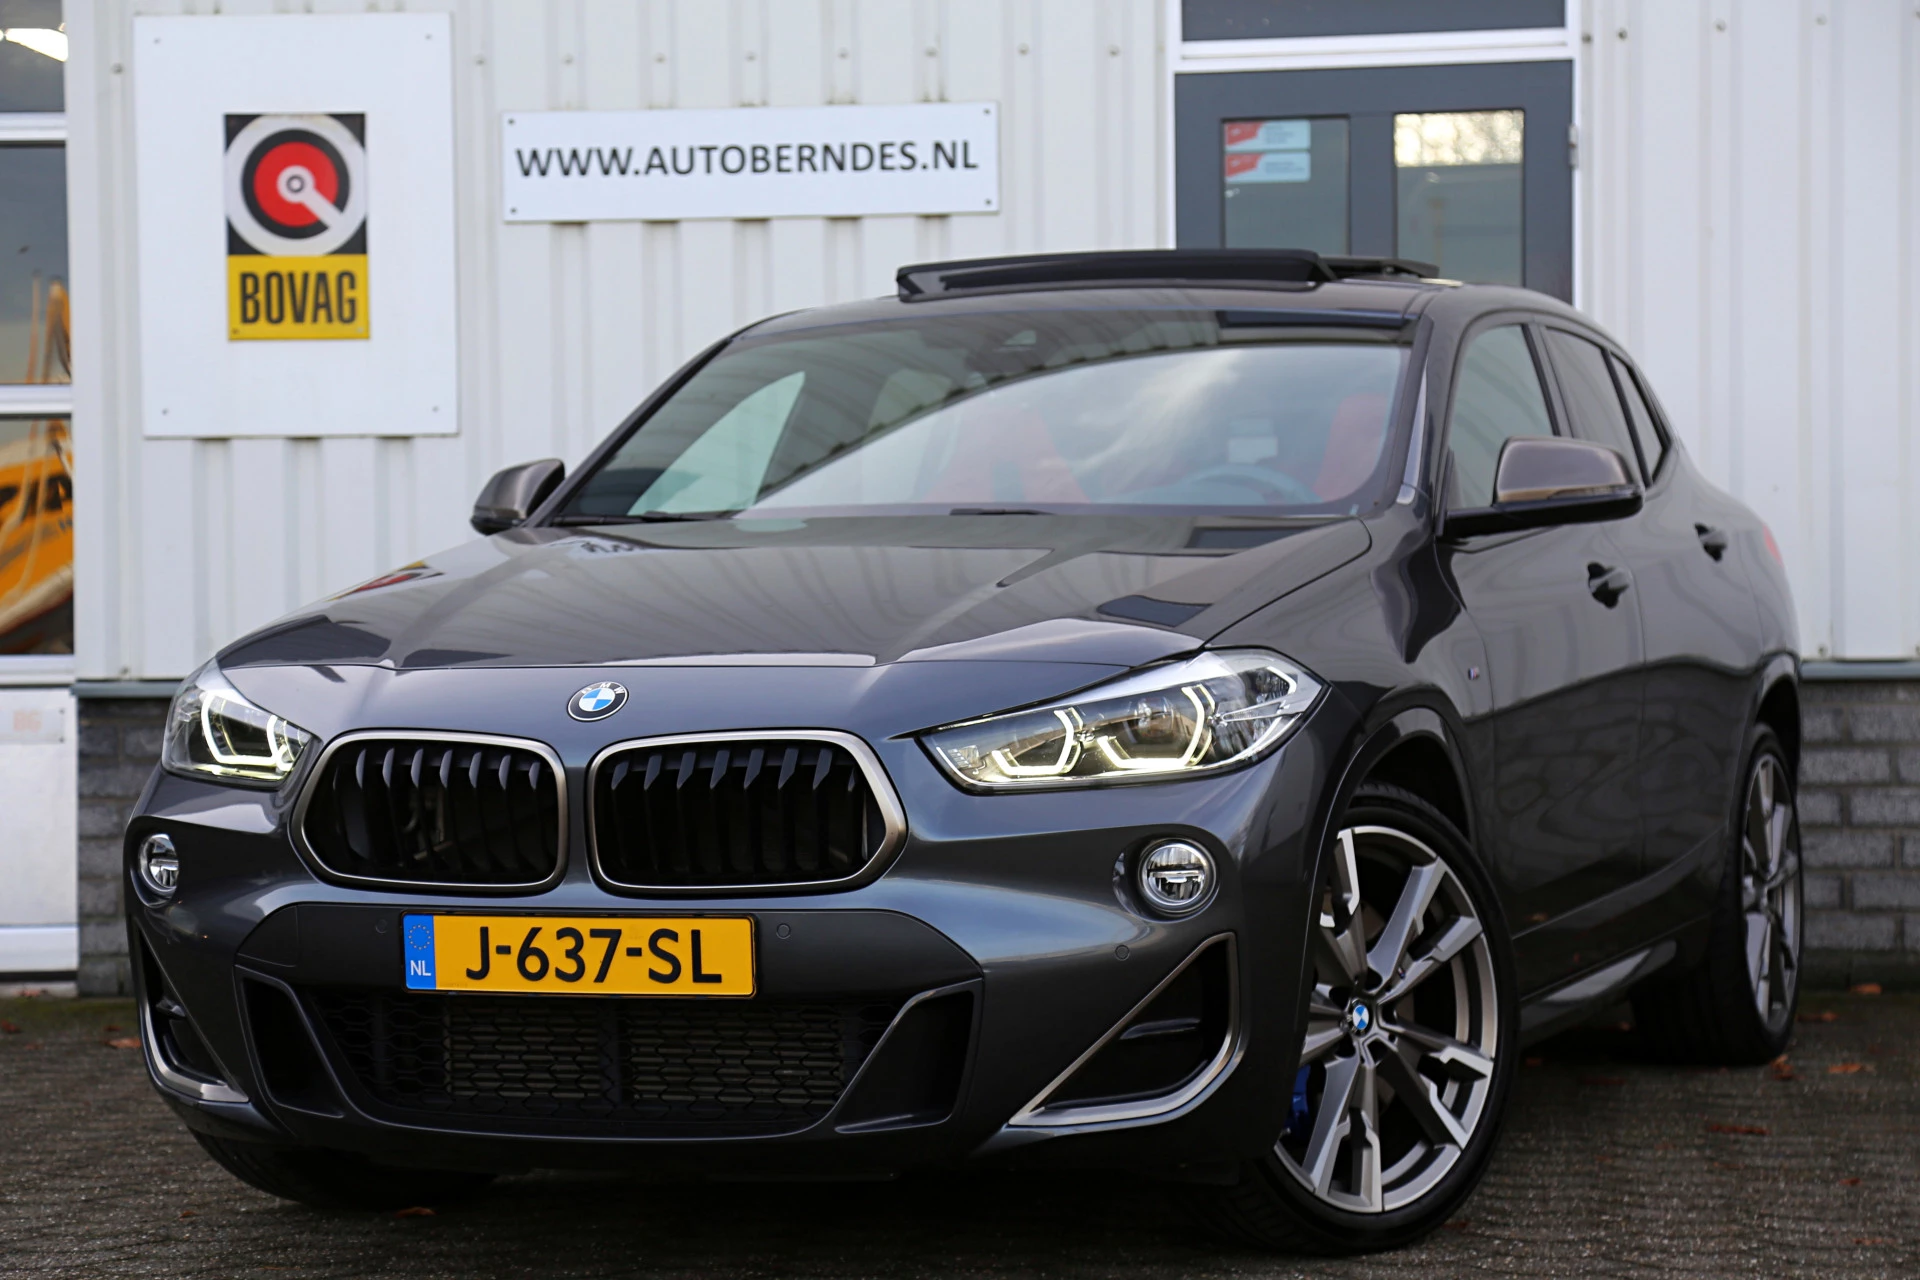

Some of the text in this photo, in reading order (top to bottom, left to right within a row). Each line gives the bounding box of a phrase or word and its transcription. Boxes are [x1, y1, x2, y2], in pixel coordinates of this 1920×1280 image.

[515, 140, 978, 177] WWW.AUTOBERNDES.NL
[239, 270, 357, 325] BOVAG
[409, 960, 432, 977] NL
[465, 926, 723, 984] J-637-SL
